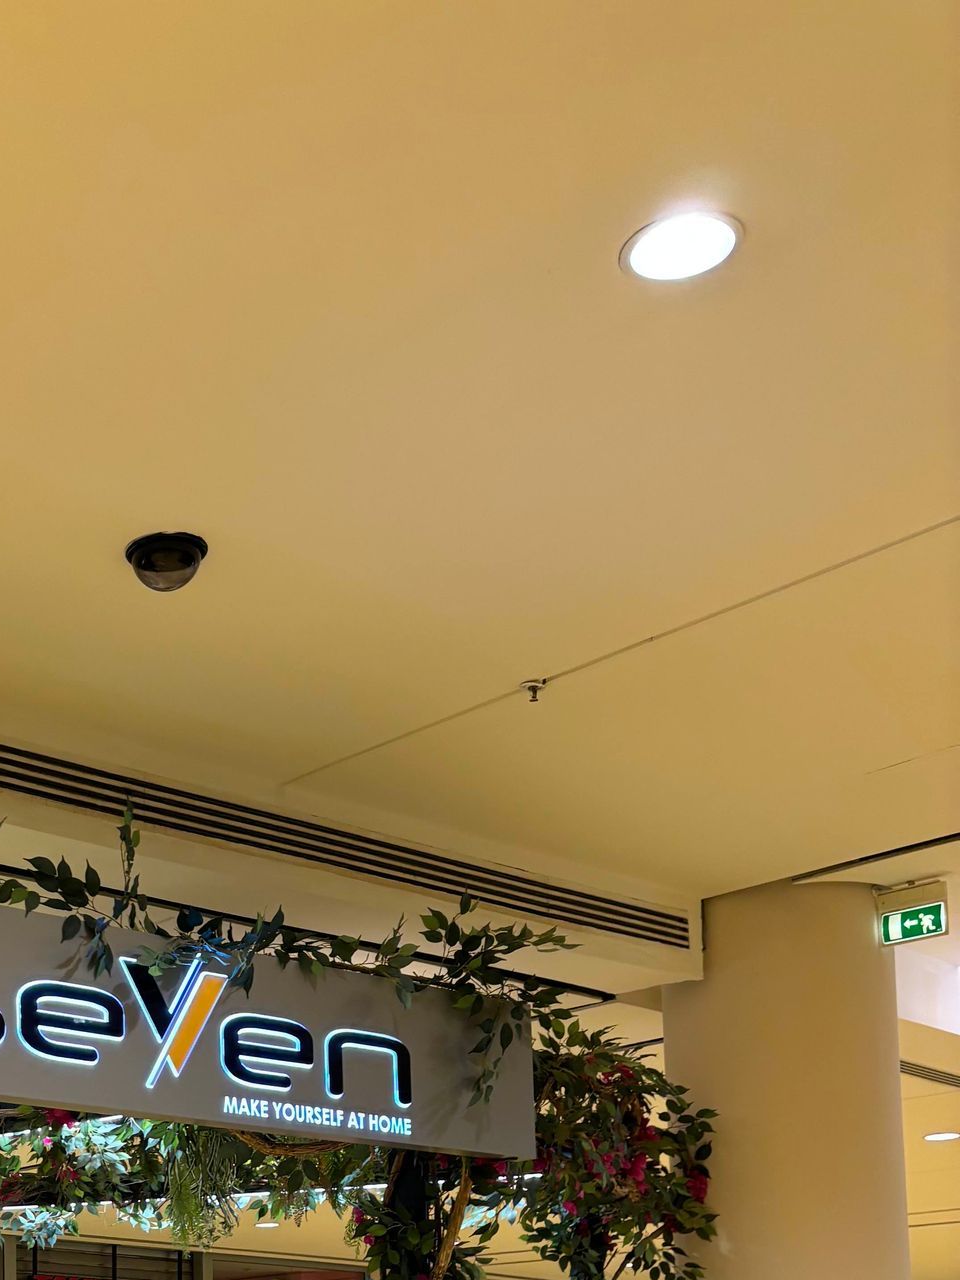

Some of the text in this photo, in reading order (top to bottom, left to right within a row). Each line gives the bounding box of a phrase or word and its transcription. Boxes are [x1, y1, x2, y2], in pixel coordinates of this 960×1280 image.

[223, 1096, 412, 1135] MAKE YOURSELF AT HOME
